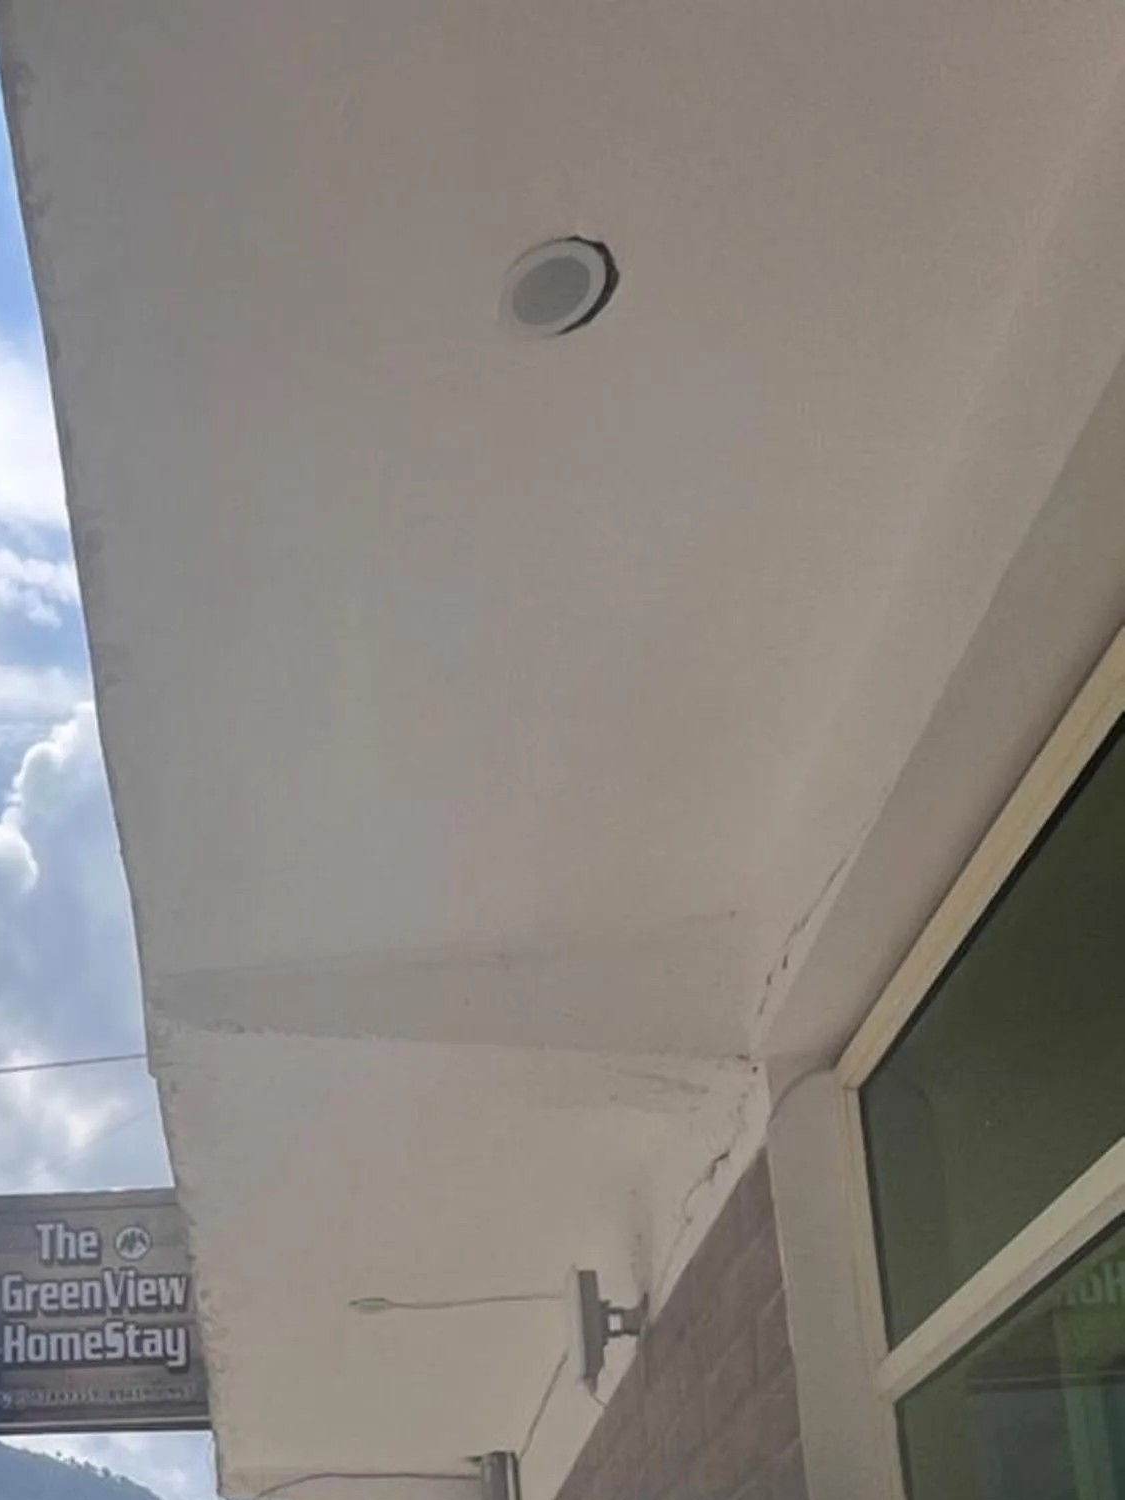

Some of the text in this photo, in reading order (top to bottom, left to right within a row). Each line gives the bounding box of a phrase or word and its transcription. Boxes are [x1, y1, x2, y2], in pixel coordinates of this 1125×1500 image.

[36, 1222, 99, 1261] The
[1, 1269, 187, 1313] GreenView
[3, 1321, 187, 1367] HomeStay
